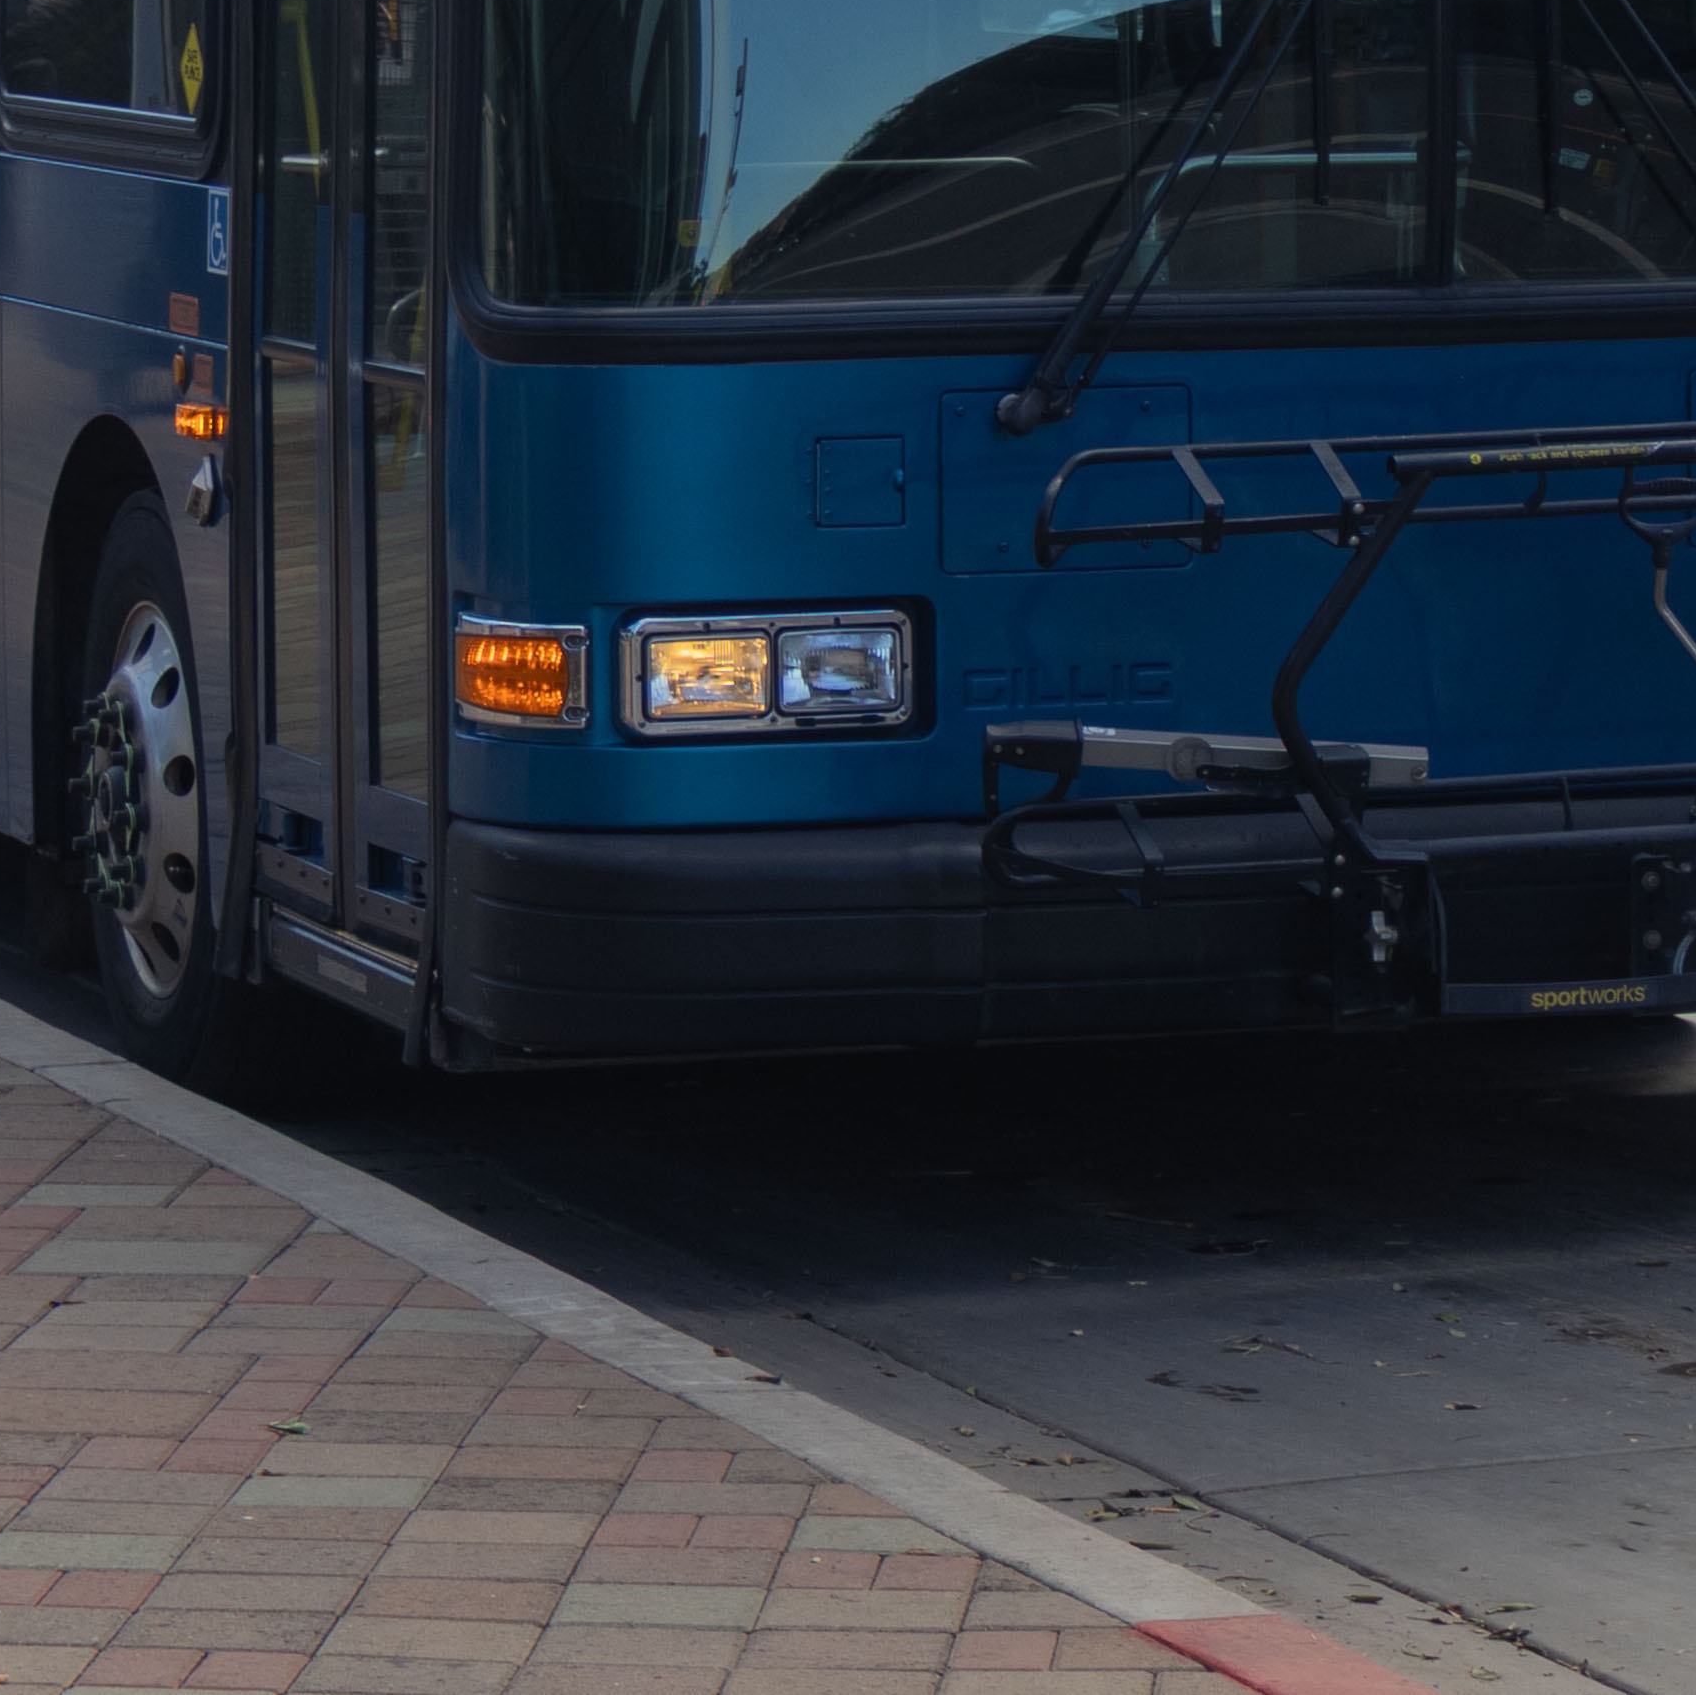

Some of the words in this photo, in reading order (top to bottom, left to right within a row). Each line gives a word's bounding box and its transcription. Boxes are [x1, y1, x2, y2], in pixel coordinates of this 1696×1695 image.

[1550, 450, 1569, 459] and
[963, 661, 1174, 711] GILLIG
[1531, 984, 1646, 1011] sportworks
